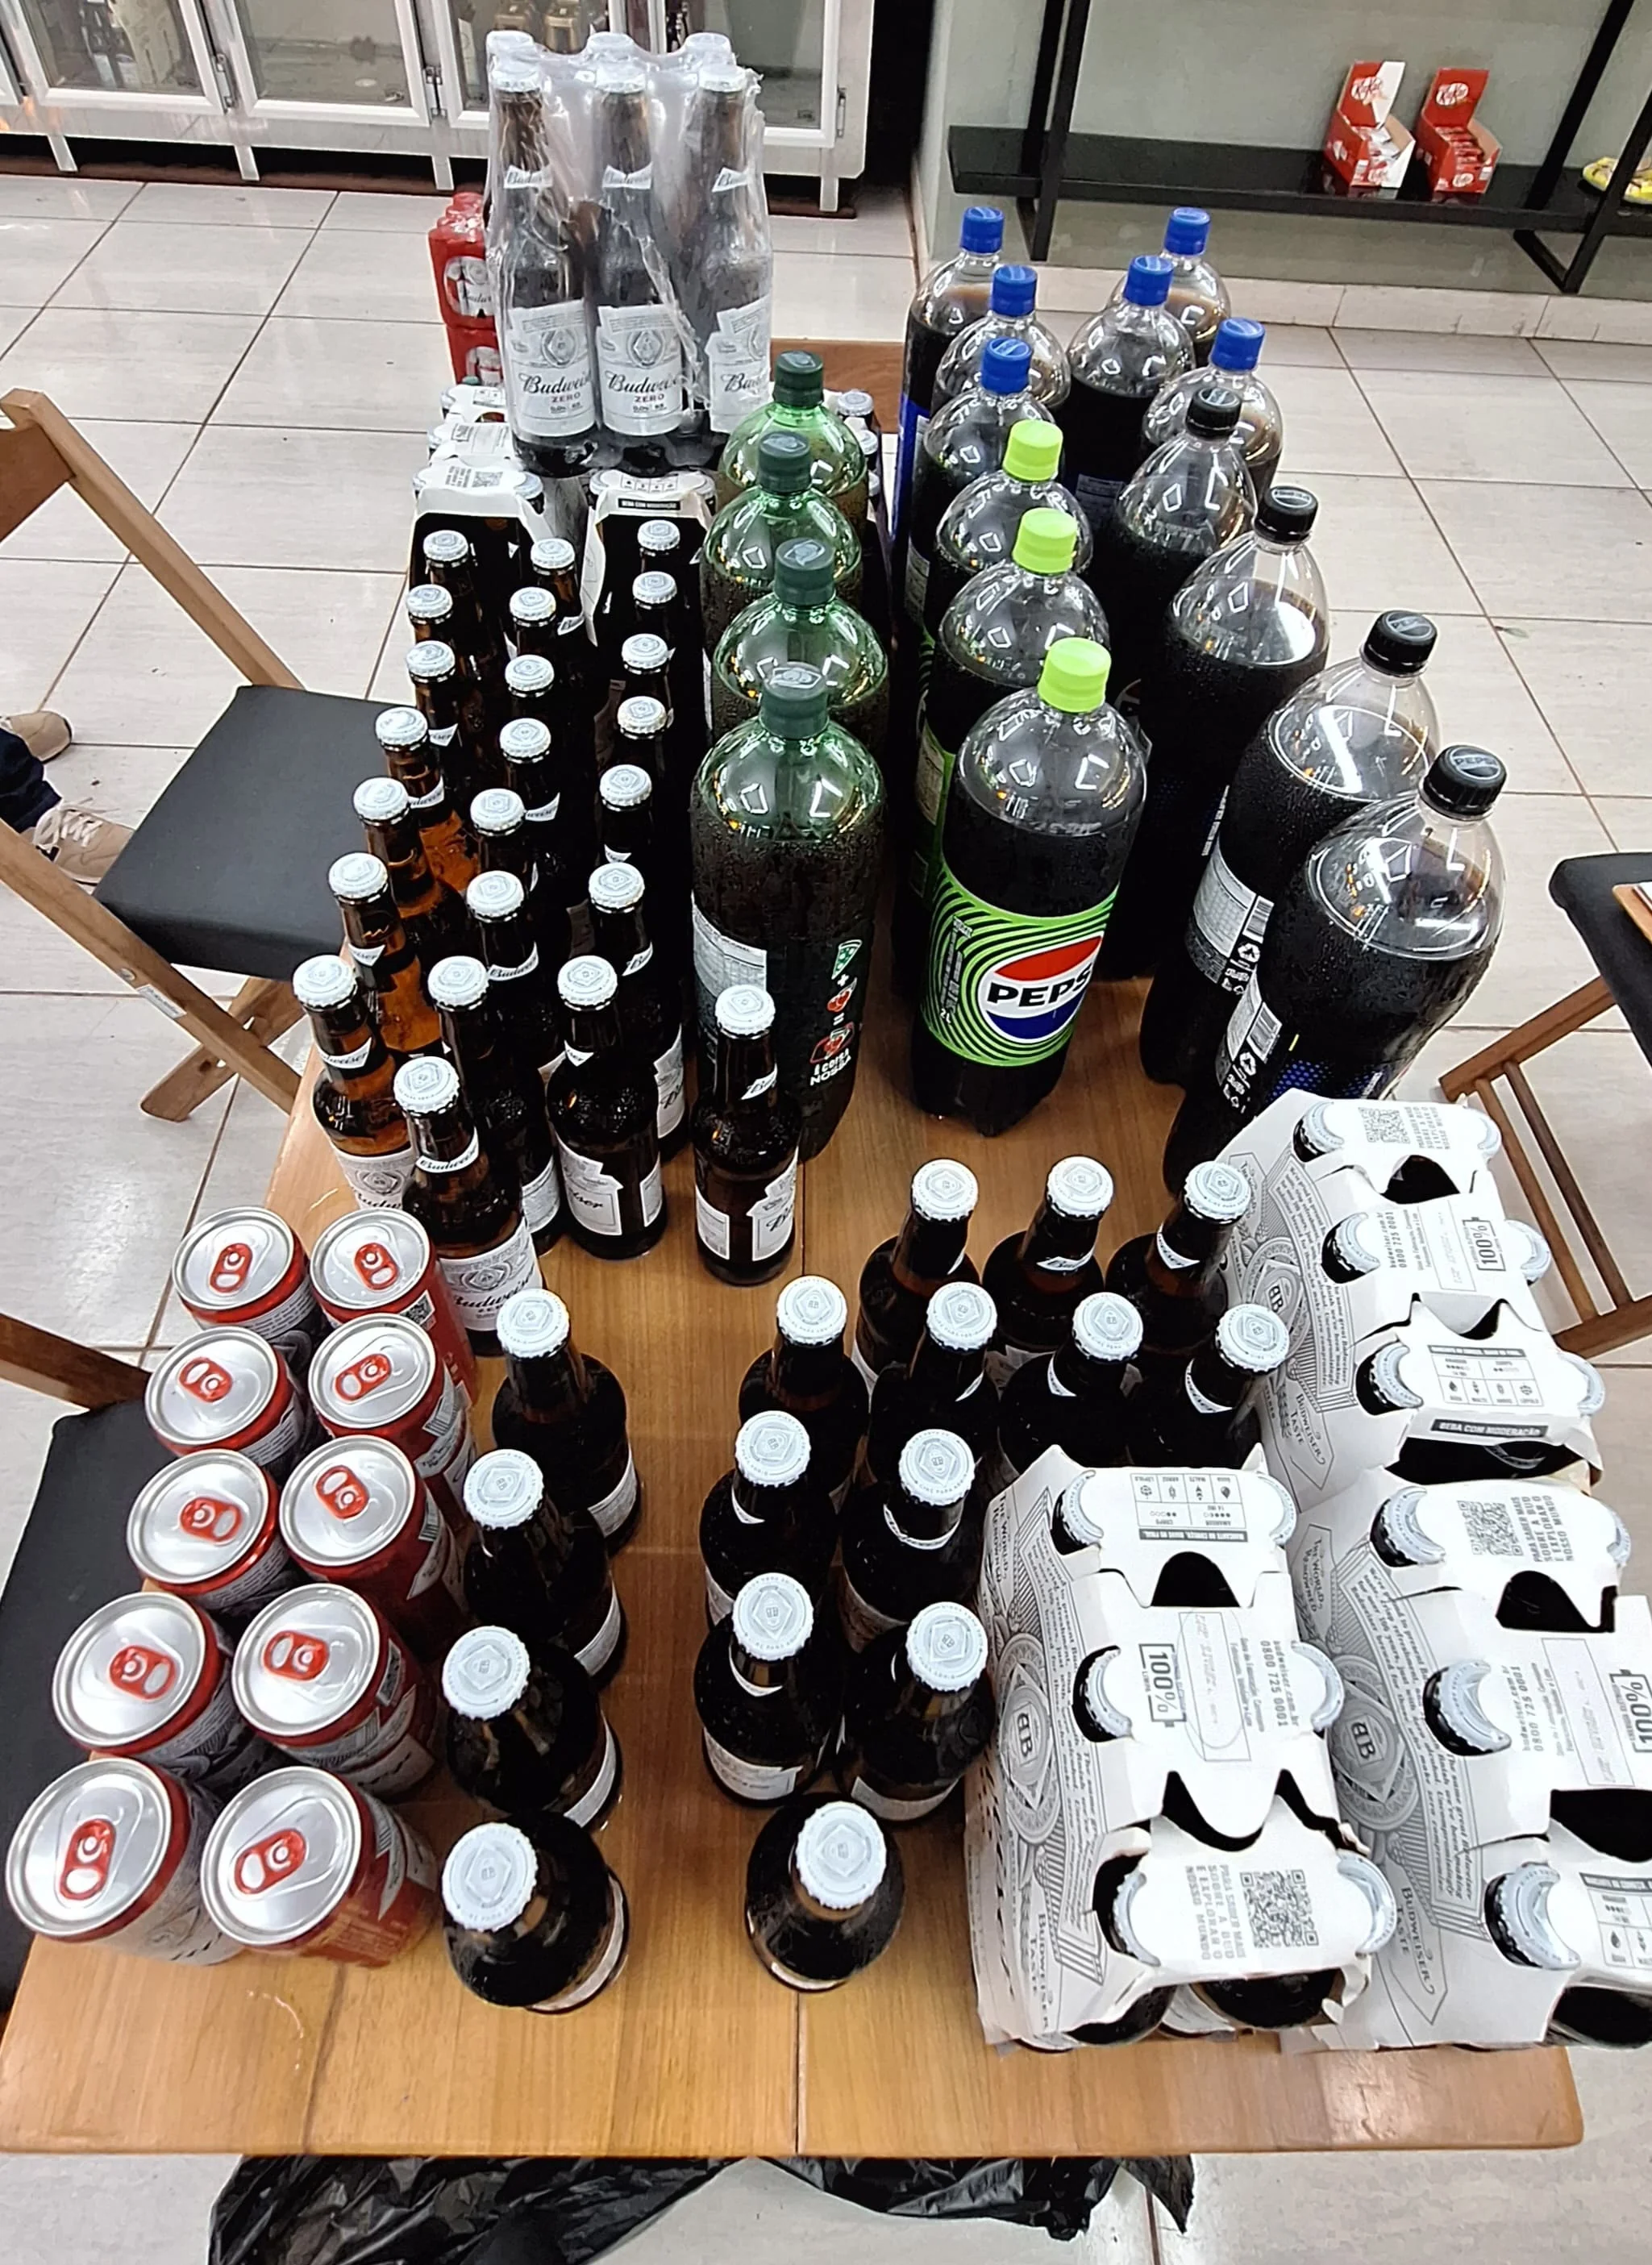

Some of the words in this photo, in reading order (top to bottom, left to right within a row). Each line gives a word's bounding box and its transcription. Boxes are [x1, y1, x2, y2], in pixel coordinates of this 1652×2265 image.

[551, 392, 580, 403] ZERO
[635, 393, 664, 403] ZERO
[988, 963, 1093, 1007] PEPS
[1469, 1224, 1497, 1265] 100%
[1289, 1409, 1304, 1445] TASTE
[1296, 1393, 1321, 1458] BUDWEISER
[1259, 1638, 1275, 1668] 0800
[1147, 1651, 1179, 1713] 100%
[1267, 1672, 1282, 1693] 725
[1510, 1664, 1528, 1693] 0001
[1272, 1697, 1288, 1726] 0001
[1528, 1721, 1544, 1752] 0800
[1395, 1905, 1409, 1955] TASTE
[1400, 1886, 1432, 1986] BUDWEISER
[1030, 1934, 1038, 1995] TASTE
[1038, 1913, 1048, 2027] BUDWEISER
